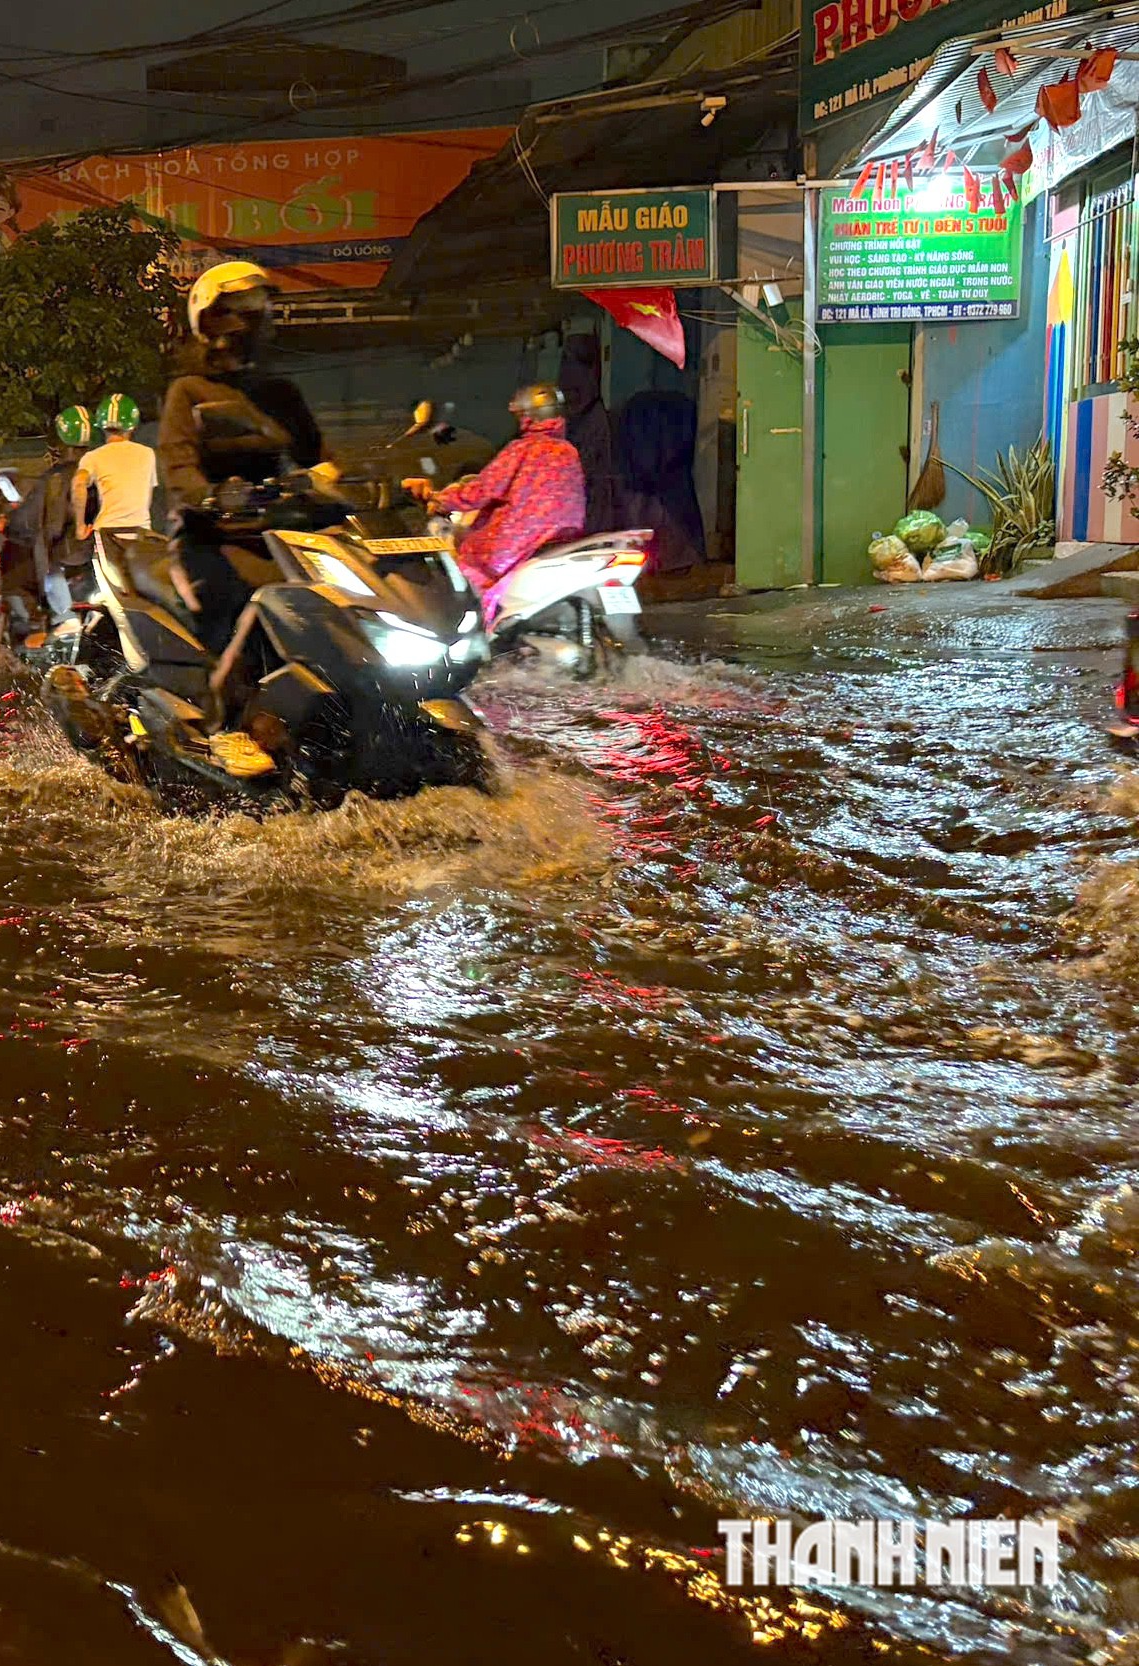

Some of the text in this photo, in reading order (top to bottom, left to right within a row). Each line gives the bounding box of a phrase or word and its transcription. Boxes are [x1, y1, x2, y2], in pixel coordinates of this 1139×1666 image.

[829, 93, 842, 113] 121
[214, 146, 290, 175] TỔNG
[305, 147, 360, 170] HỢP
[872, 198, 901, 211] Non
[577, 200, 689, 233] MẪU GIÁO
[966, 219, 974, 232] 5
[829, 240, 862, 252] CHƯƠNG
[864, 239, 888, 251] TRÌNH
[562, 232, 706, 279] PHƯƠNG TRÂM
[829, 254, 842, 264] VUI
[844, 254, 861, 266] HỌC
[867, 252, 889, 264] SÁNG
[891, 253, 907, 265] TẠO
[828, 268, 845, 279] HỌC
[846, 266, 866, 277] THEO
[868, 265, 901, 277] CHƯƠNG
[928, 263, 949, 275] GIÁO
[949, 264, 966, 276] DỤC
[990, 262, 1009, 273] NON
[828, 281, 845, 291] ANH
[864, 278, 884, 290] GIÁO
[962, 276, 988, 286] TRONG
[990, 274, 1013, 286] NƯỚC
[850, 291, 885, 302] AEROBIC
[892, 290, 913, 301] YOGA
[972, 288, 989, 298] DUY
[835, 307, 847, 319] 121
[924, 304, 948, 318] TPHCM
